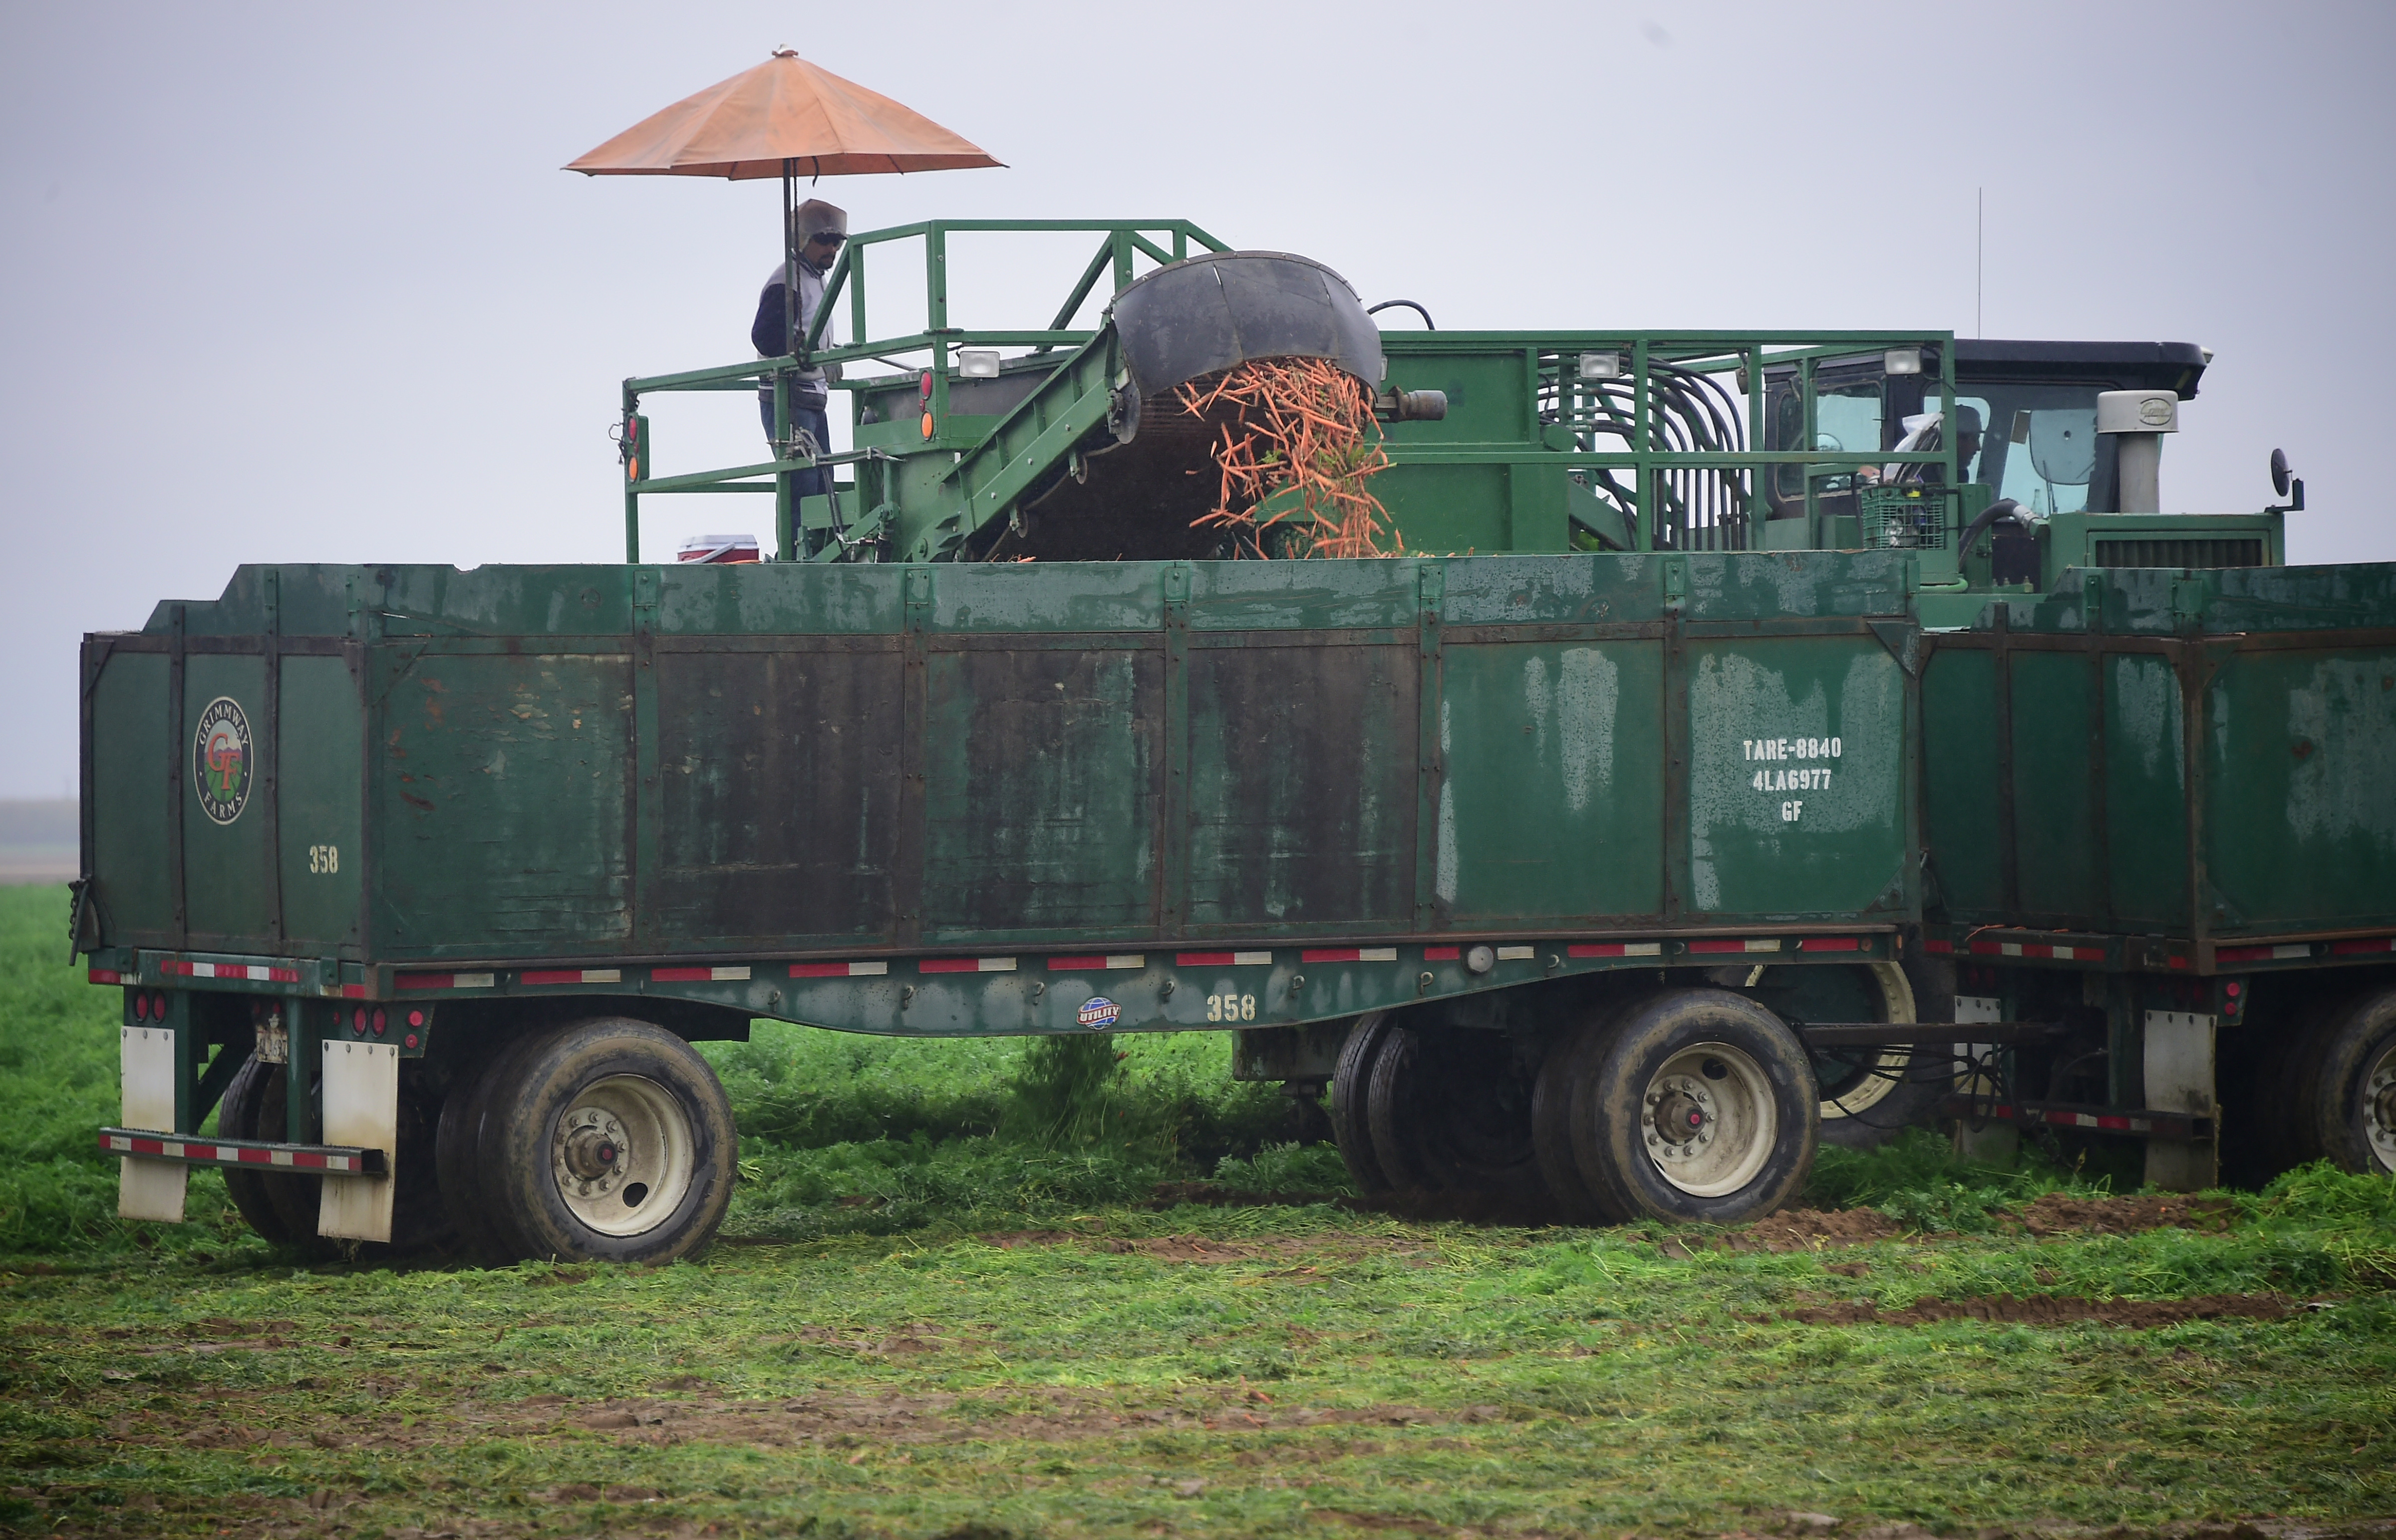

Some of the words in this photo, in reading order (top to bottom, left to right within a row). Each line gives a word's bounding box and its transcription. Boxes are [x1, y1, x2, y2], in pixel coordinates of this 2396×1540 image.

[199, 704, 249, 746] GRIMMWAY
[1744, 738, 1841, 760] TARE-8840
[1753, 770, 1831, 790] 4LA6977
[204, 791, 242, 818] FARMS
[1782, 801, 1802, 821] GF
[309, 845, 338, 874] 358
[1080, 1006, 1119, 1022] UTILITY
[1207, 994, 1255, 1022] 358
